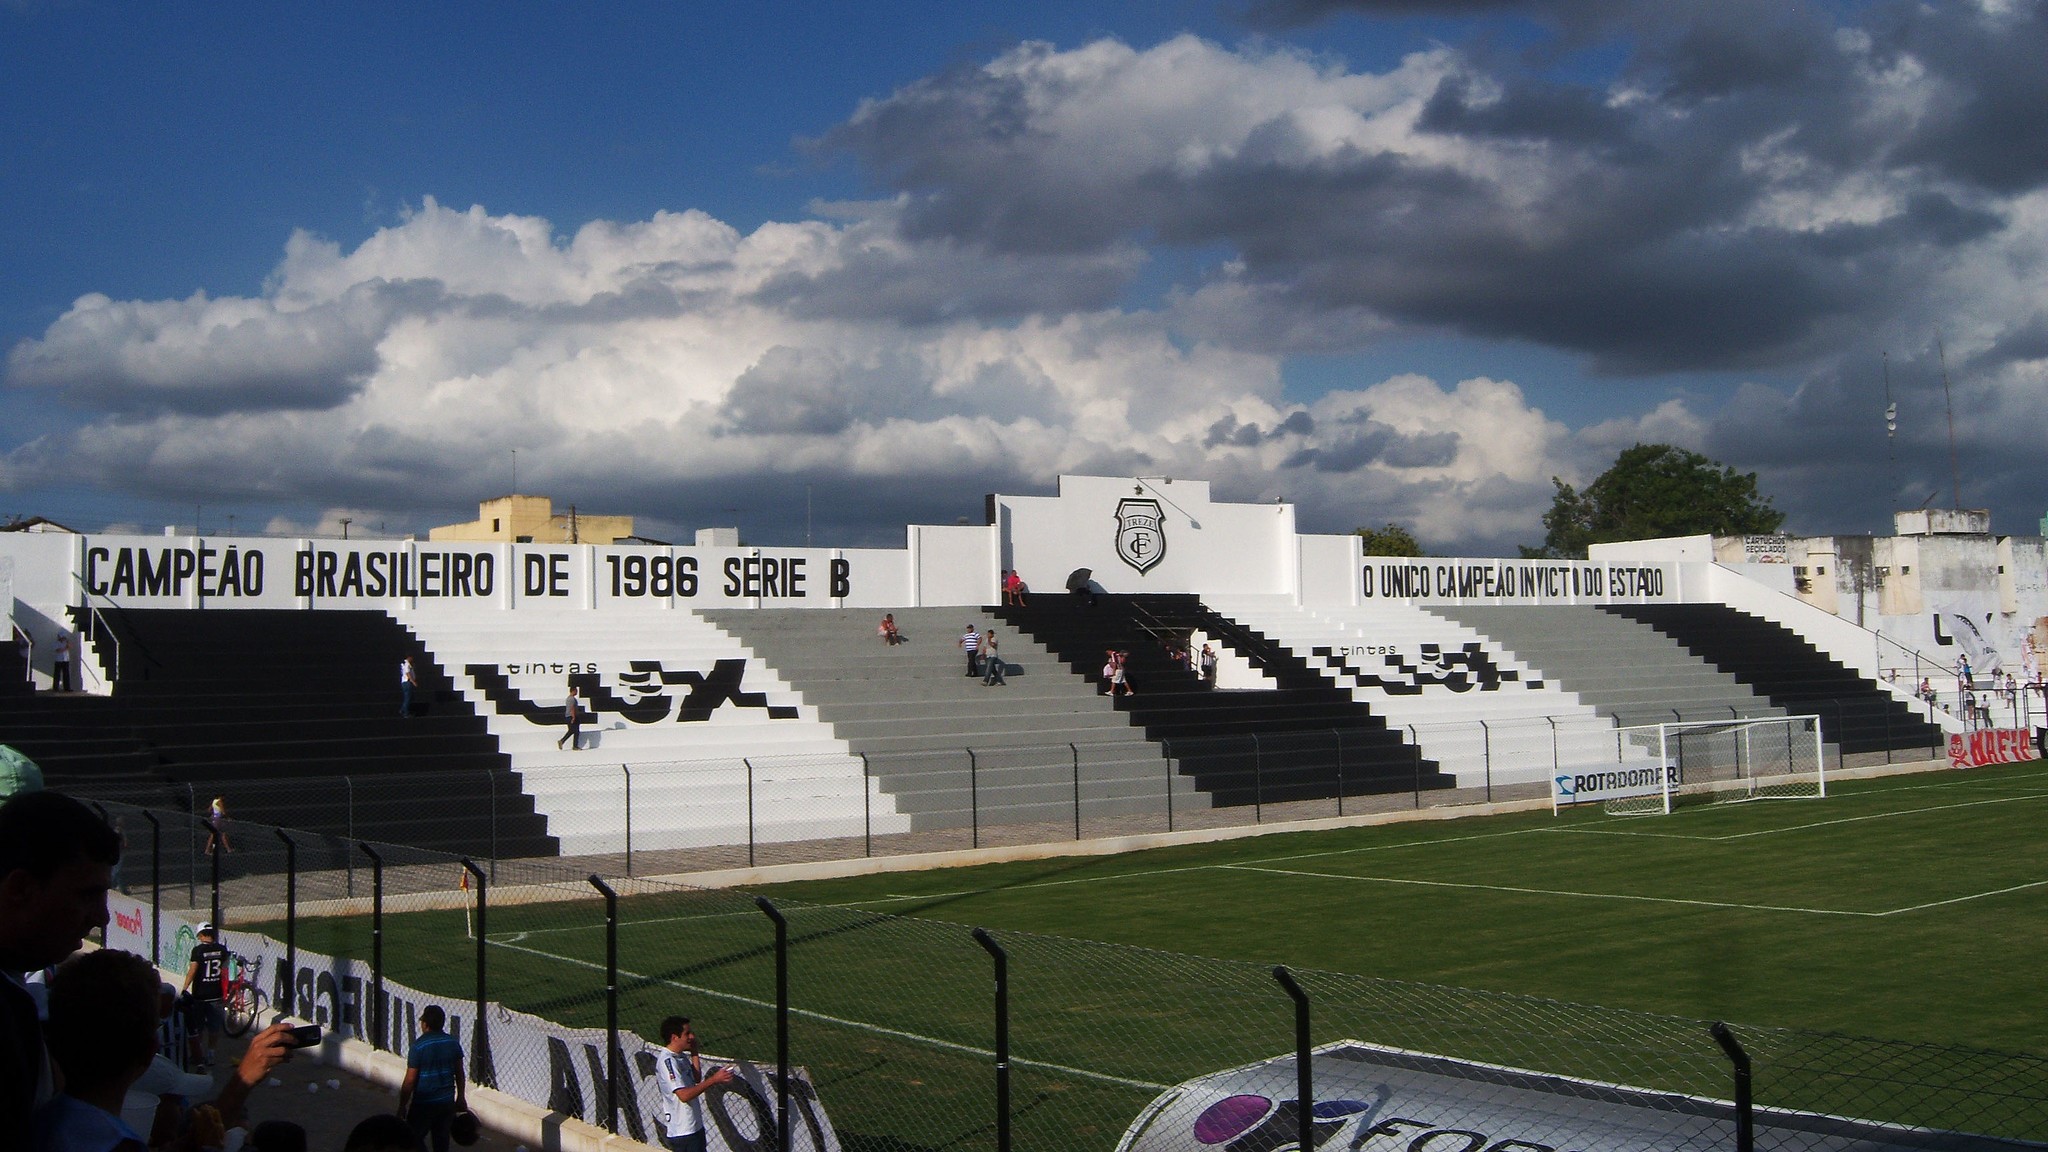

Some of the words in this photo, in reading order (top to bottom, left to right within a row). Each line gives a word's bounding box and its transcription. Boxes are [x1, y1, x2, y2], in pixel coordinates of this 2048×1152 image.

[1127, 518, 1154, 528] TREZE
[1746, 545, 1787, 554] RECICLADOS
[87, 545, 264, 597] CAMPEÃO
[295, 551, 494, 597] BRASILEIRO
[525, 553, 569, 596] DE
[606, 555, 698, 597] 1986
[723, 551, 806, 597] SÉRIE
[830, 558, 850, 598] B
[1363, 565, 1374, 598] O
[1381, 565, 1430, 598] UNICO
[1584, 567, 1602, 597] DO
[1609, 567, 1663, 597] ESTADO
[1340, 644, 1396, 656] tintas
[507, 662, 597, 675] tintas
[204, 959, 221, 978] 13
